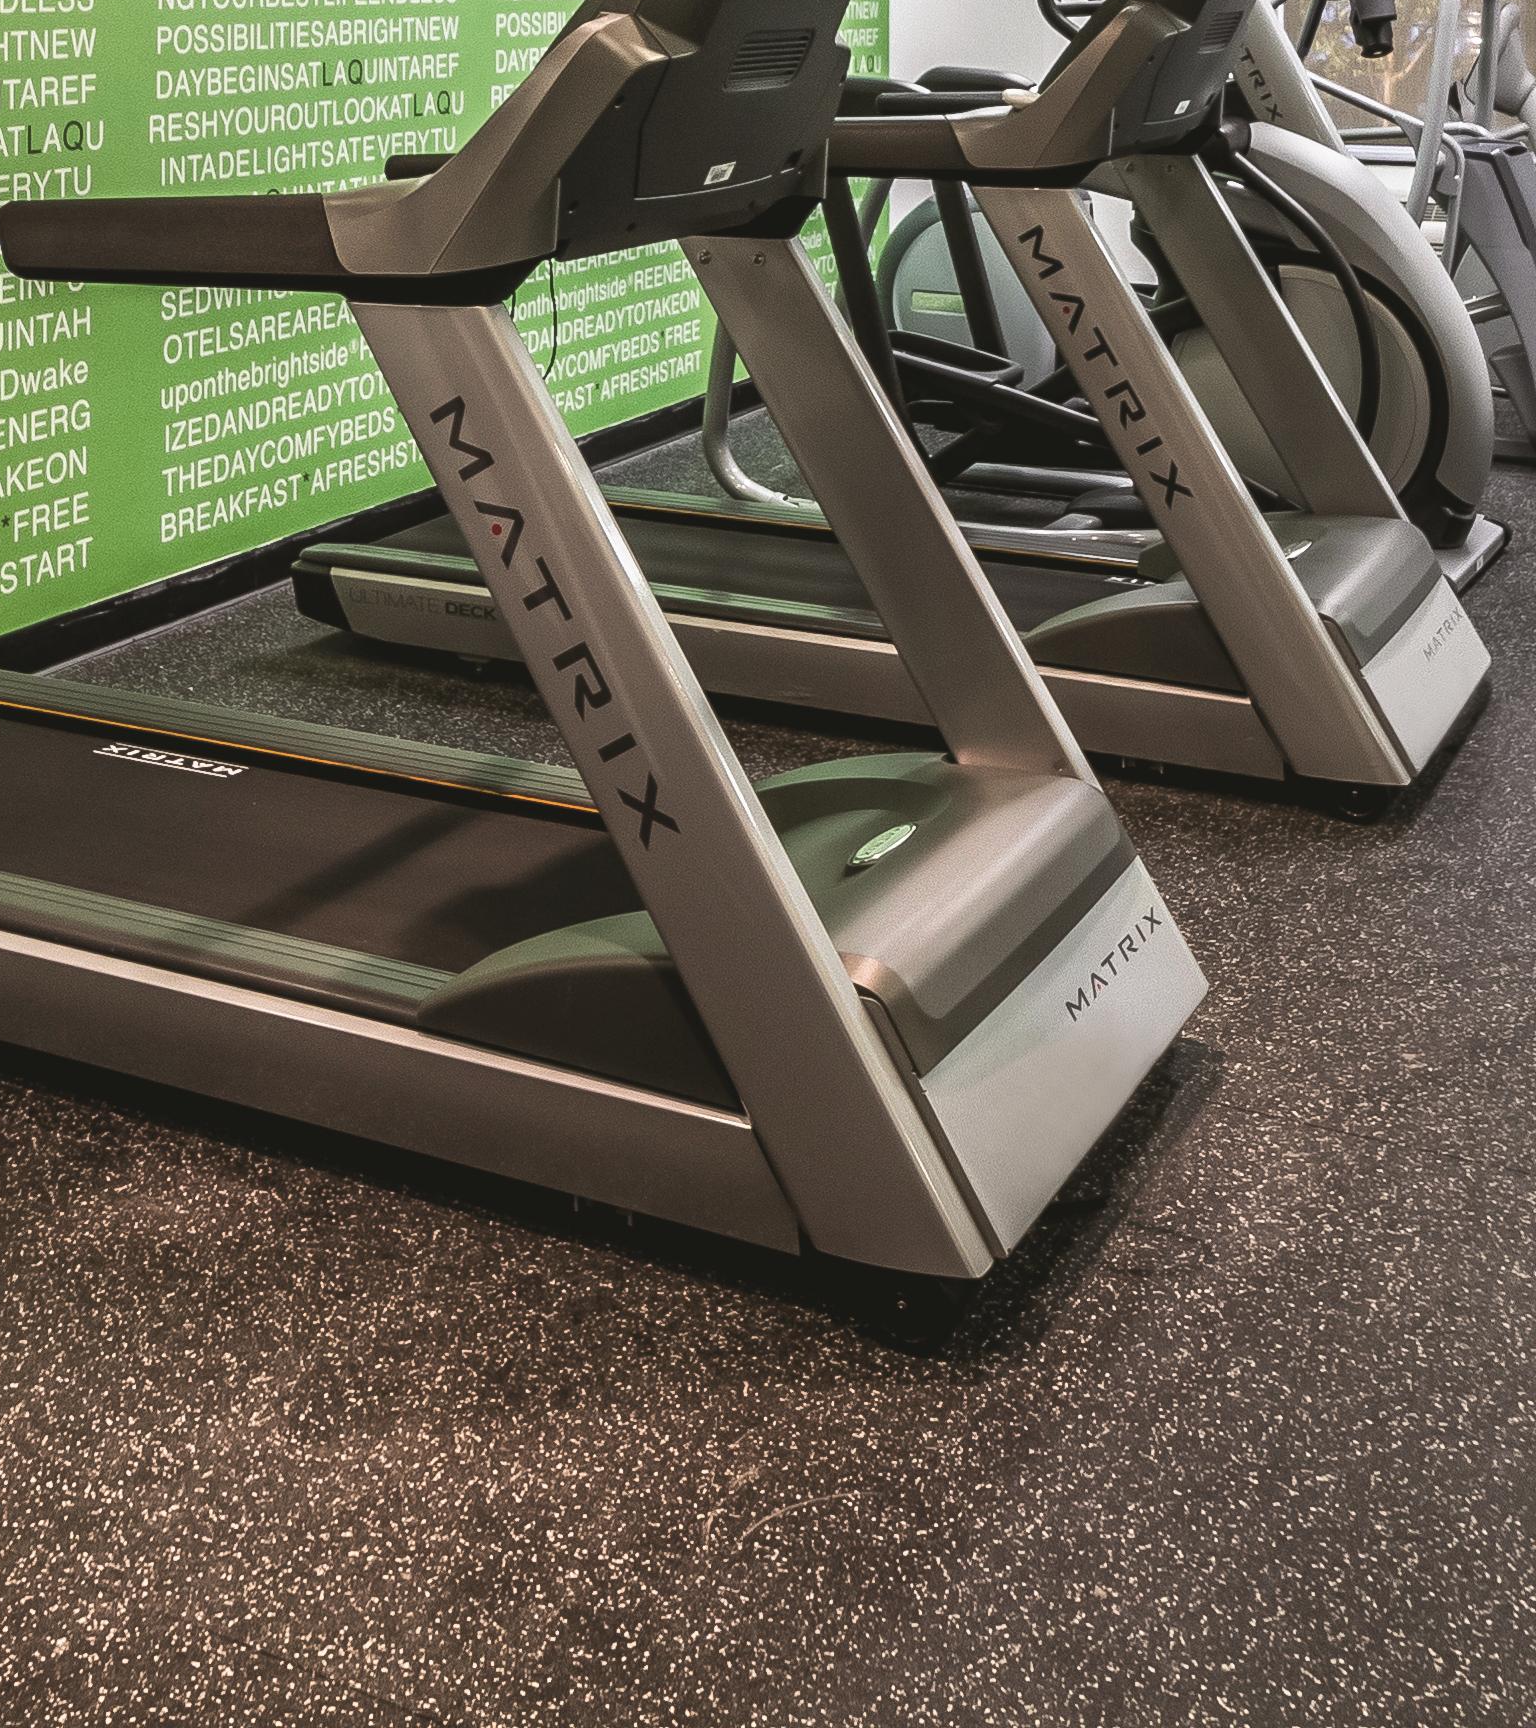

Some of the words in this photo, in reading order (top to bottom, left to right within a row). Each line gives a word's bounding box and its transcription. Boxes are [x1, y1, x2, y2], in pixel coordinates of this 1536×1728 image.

[1240, 46, 1283, 121] TRIX
[1017, 224, 1194, 510] MATRIX
[429, 395, 681, 850] MATRIX
[446, 602, 497, 620] DECK
[1423, 607, 1463, 662] MATRIX
[102, 744, 242, 776] MATRIX
[1065, 906, 1163, 1022] MATRIX
